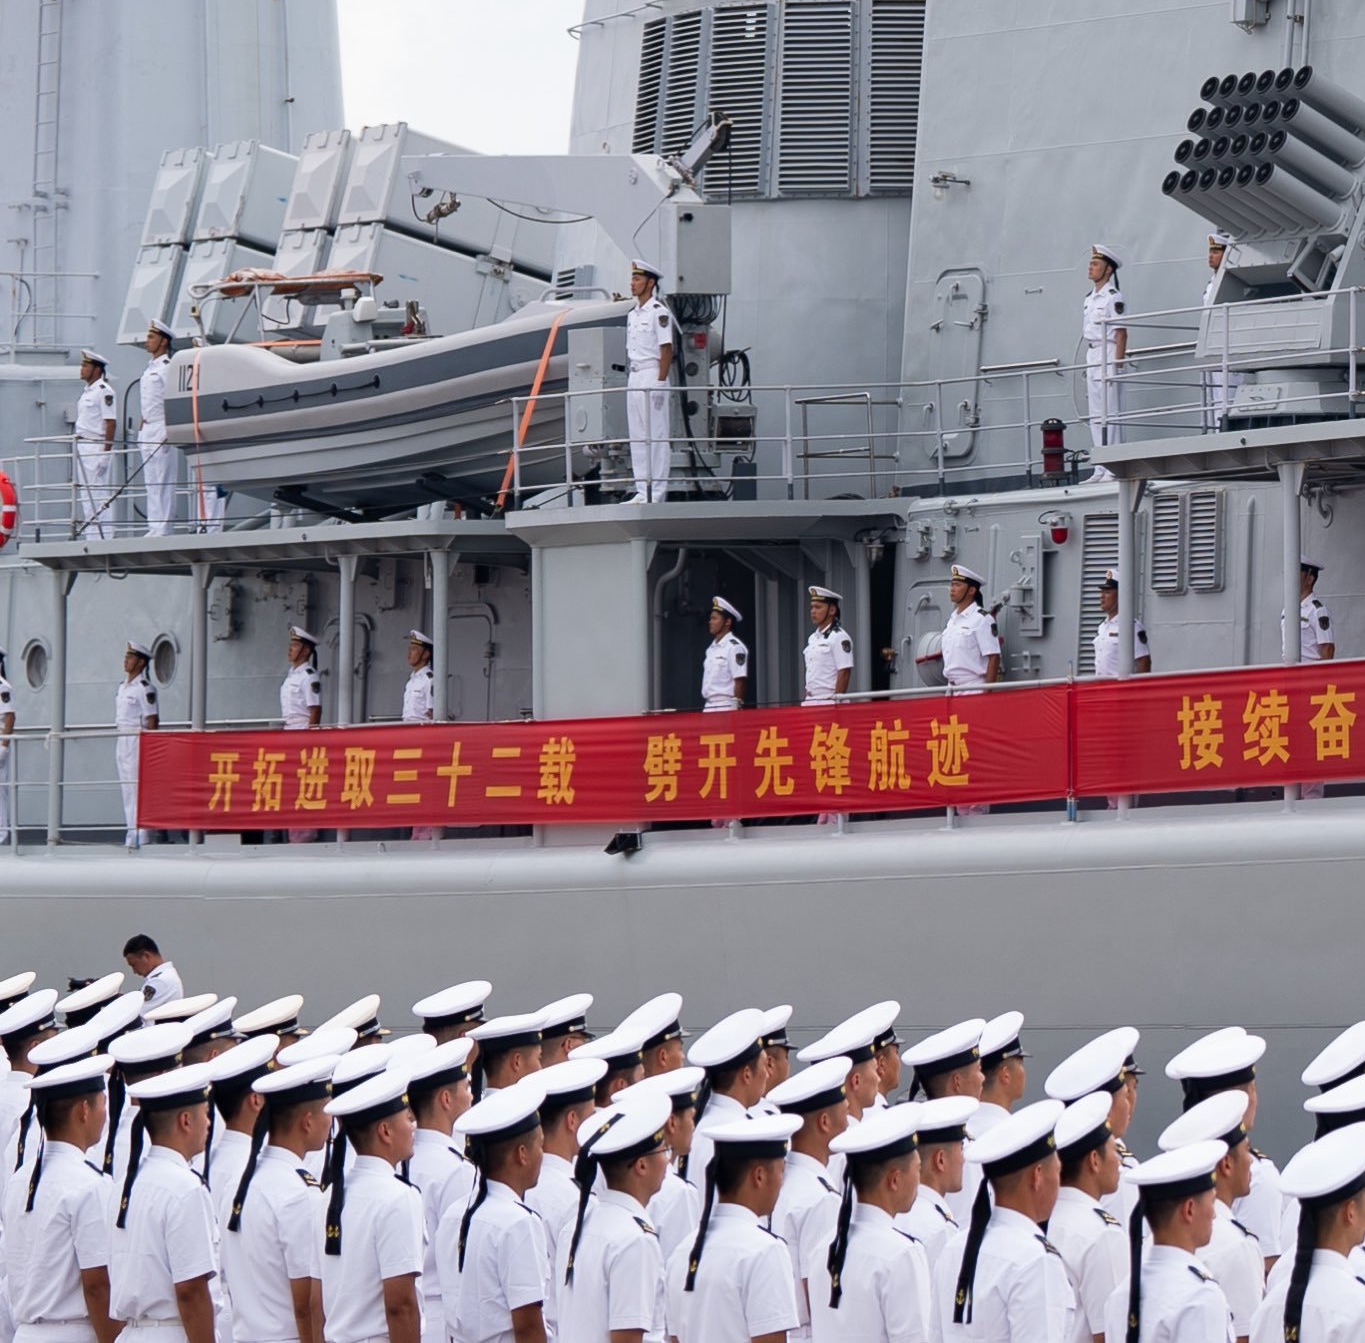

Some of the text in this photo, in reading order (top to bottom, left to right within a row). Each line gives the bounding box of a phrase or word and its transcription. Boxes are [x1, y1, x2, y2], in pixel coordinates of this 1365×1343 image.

[208, 714, 970, 812] 开拓进取三十二载 劈开先锋航迹
